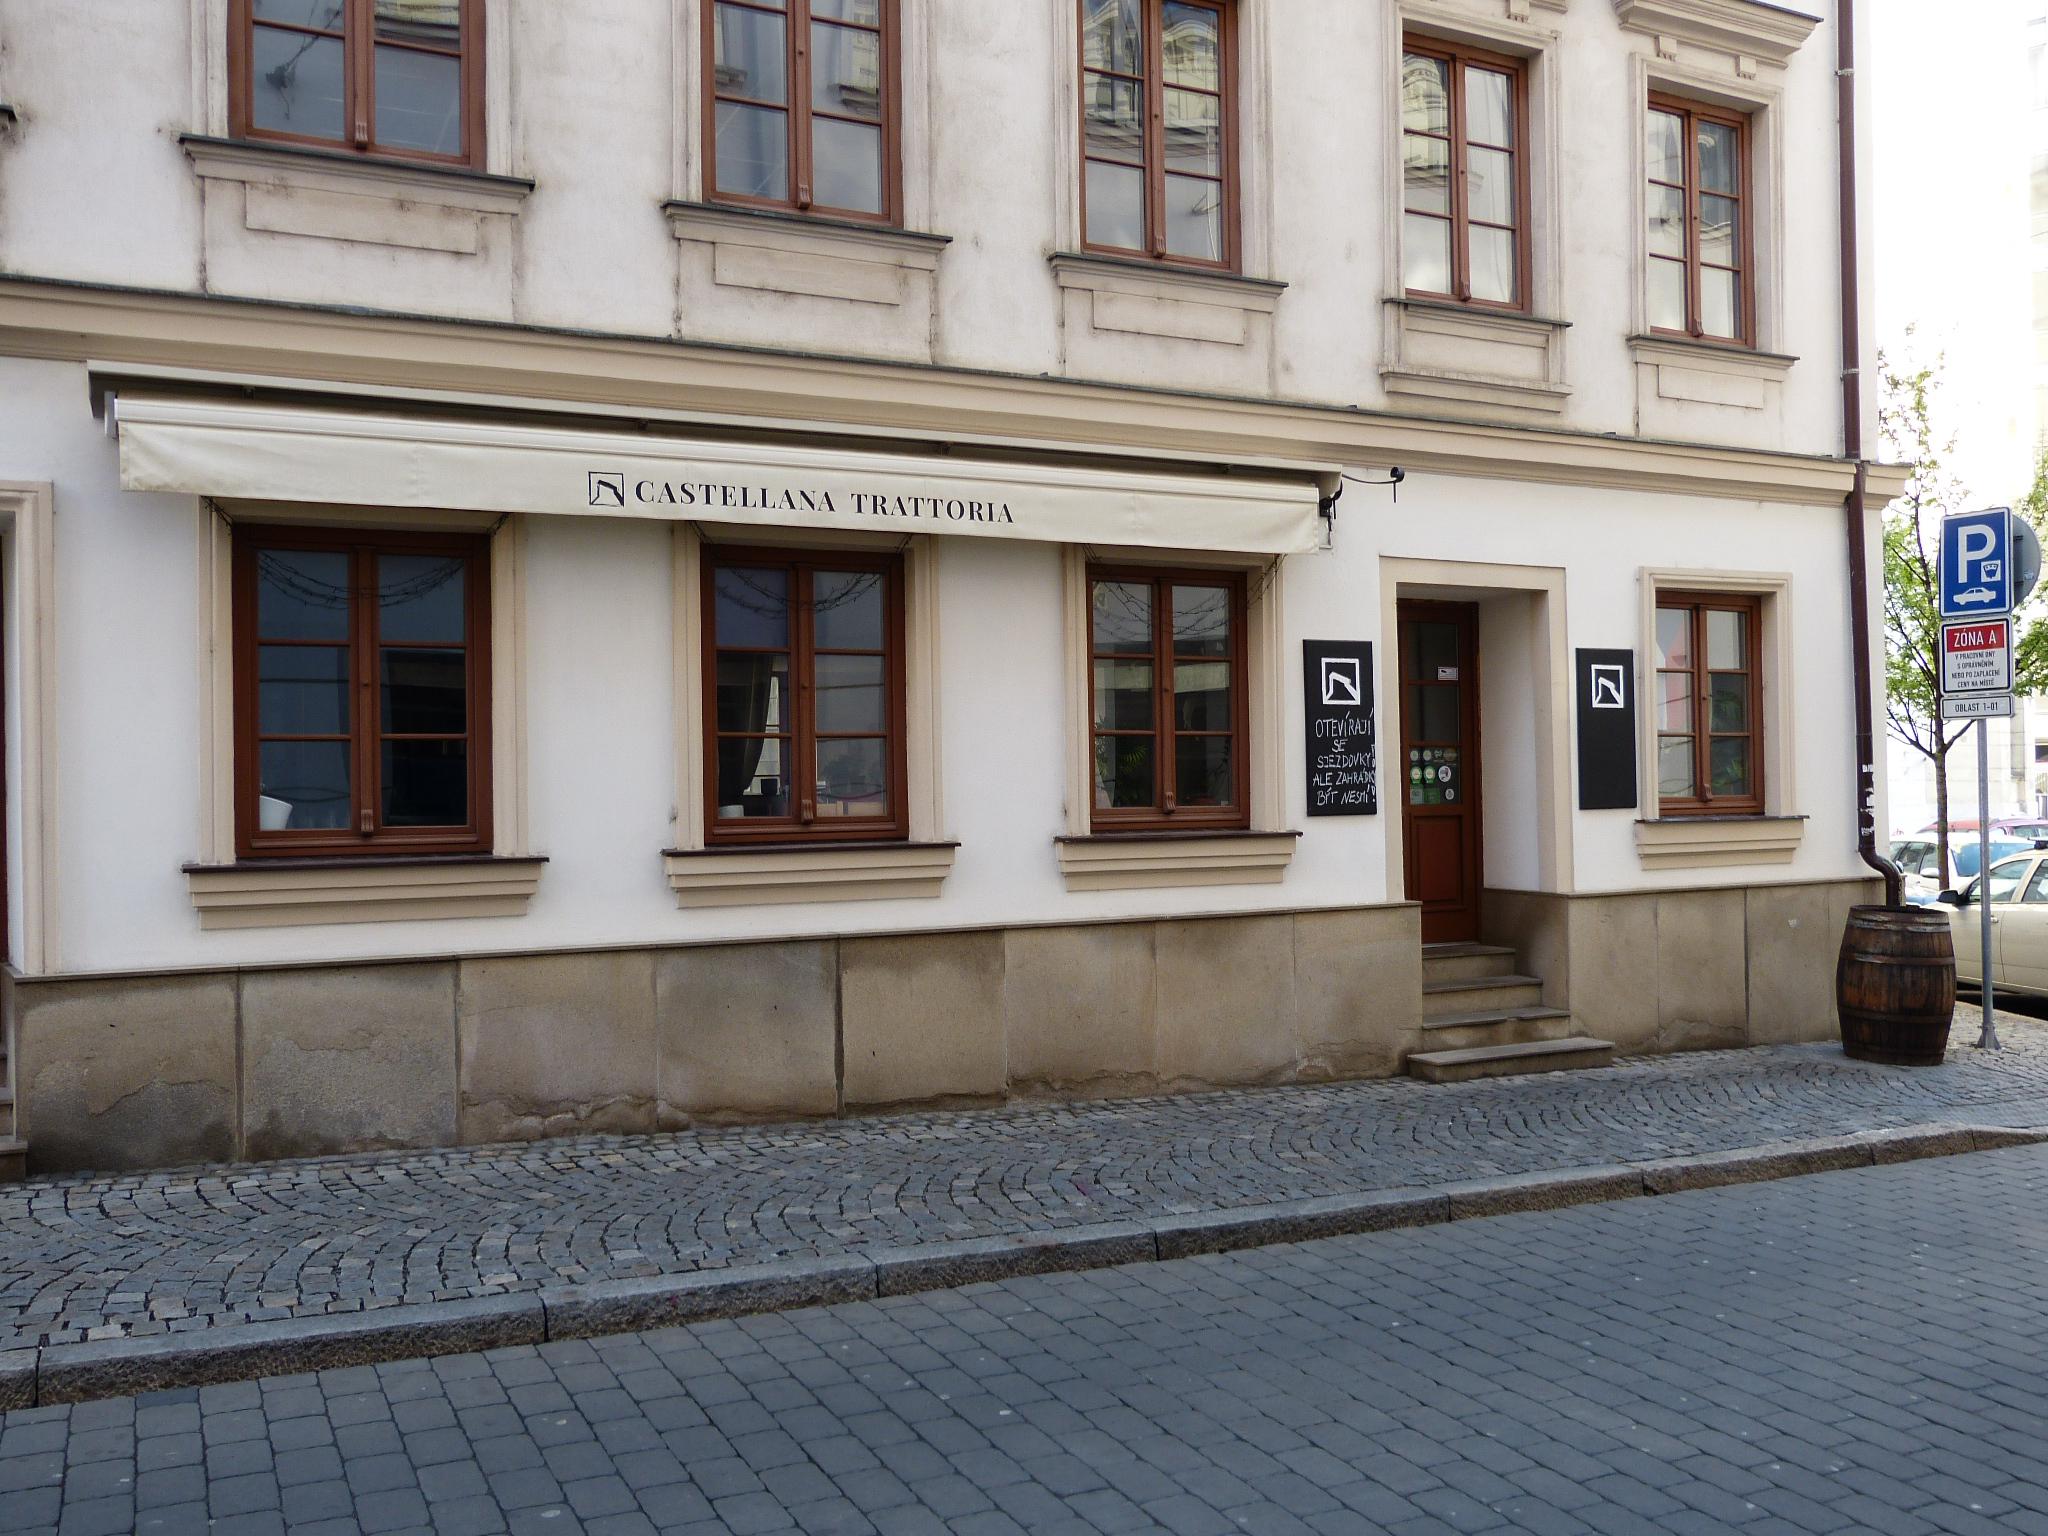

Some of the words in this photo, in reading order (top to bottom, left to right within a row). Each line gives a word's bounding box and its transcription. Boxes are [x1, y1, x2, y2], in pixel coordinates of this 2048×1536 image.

[635, 480, 836, 513] CASTELLANA
[850, 493, 1014, 524] TRATTORIA
[1958, 524, 1996, 583] P
[1953, 628, 1984, 647] ZÓNA
[1989, 629, 1997, 645] A
[1957, 680, 1970, 688] CENY
[1955, 703, 1979, 712] OBLAST
[1983, 702, 1998, 711] 1-01
[1315, 707, 1374, 738] OTEVÍRAJÍ
[1331, 739, 1348, 752] SE
[1313, 772, 1333, 786] ALE
[1317, 787, 1338, 806] BÝT
